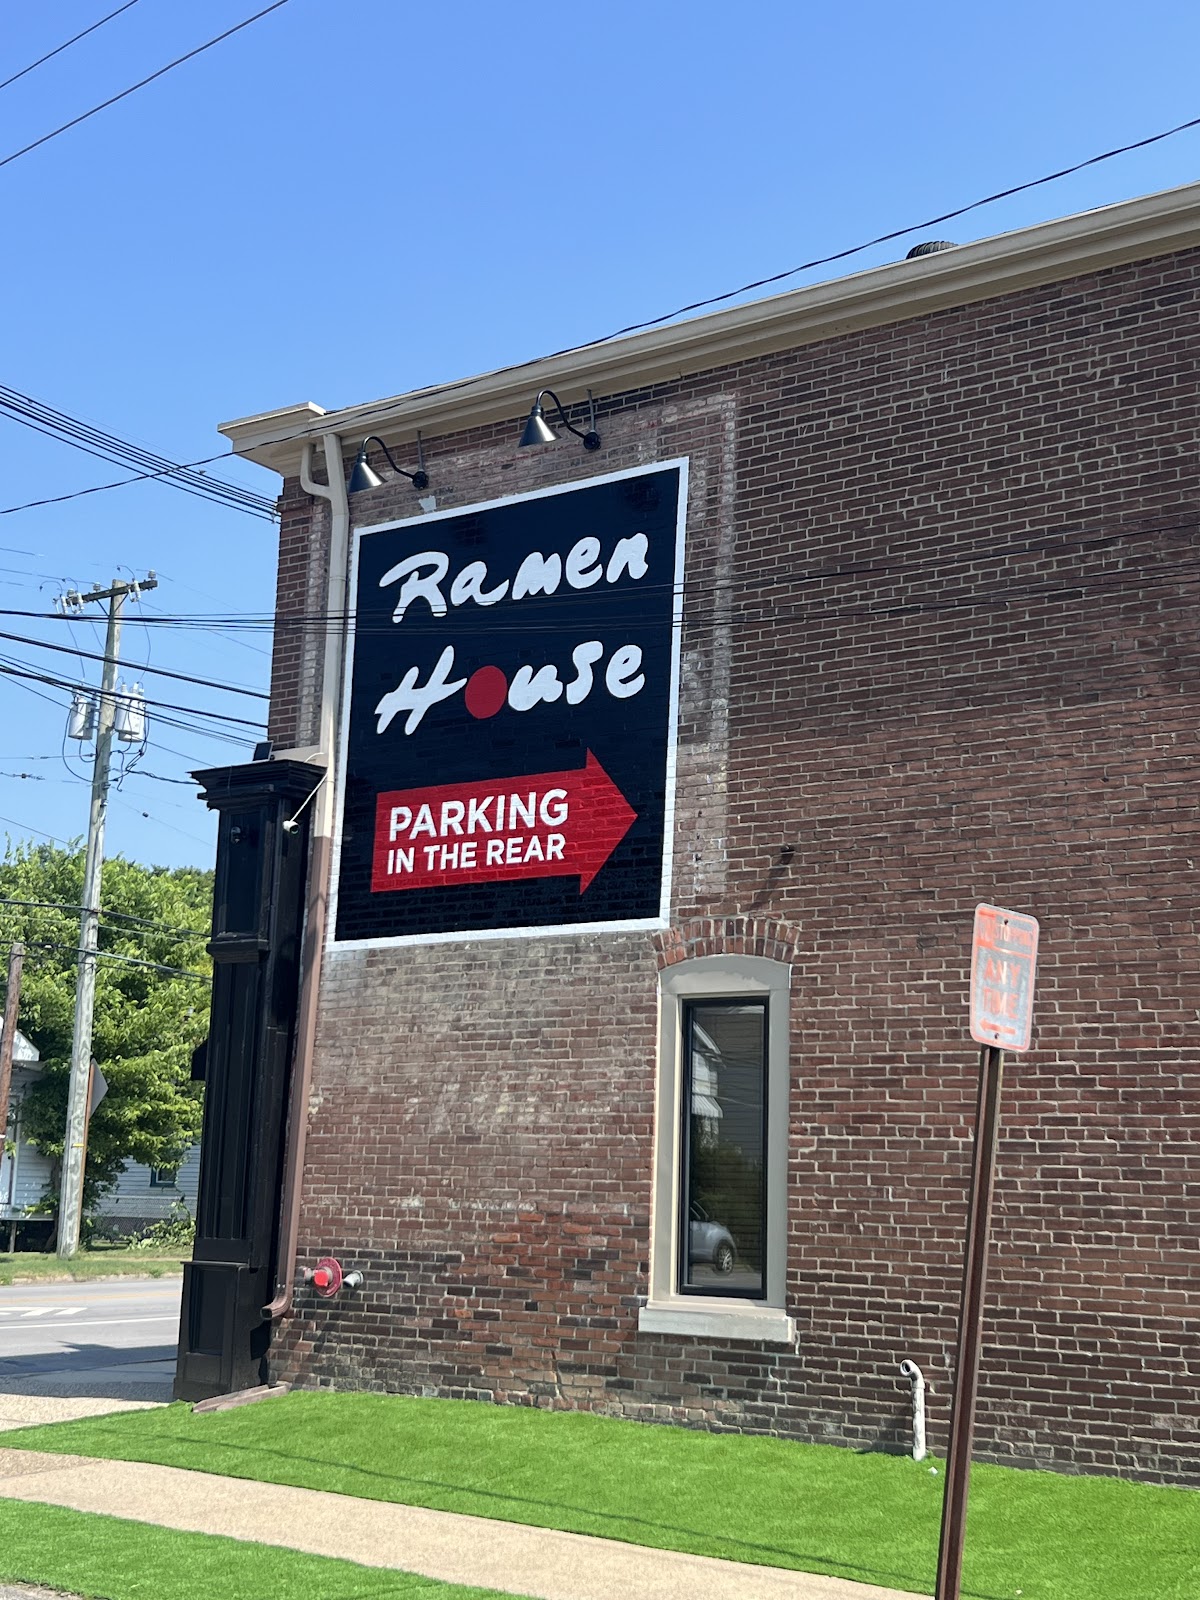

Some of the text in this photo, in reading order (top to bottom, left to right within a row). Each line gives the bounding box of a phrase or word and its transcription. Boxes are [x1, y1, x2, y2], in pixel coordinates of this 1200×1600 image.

[379, 533, 649, 623] Ramen
[389, 788, 569, 842] PARKING
[387, 833, 566, 875] IN THE REAR
[984, 957, 1021, 988] ANY
